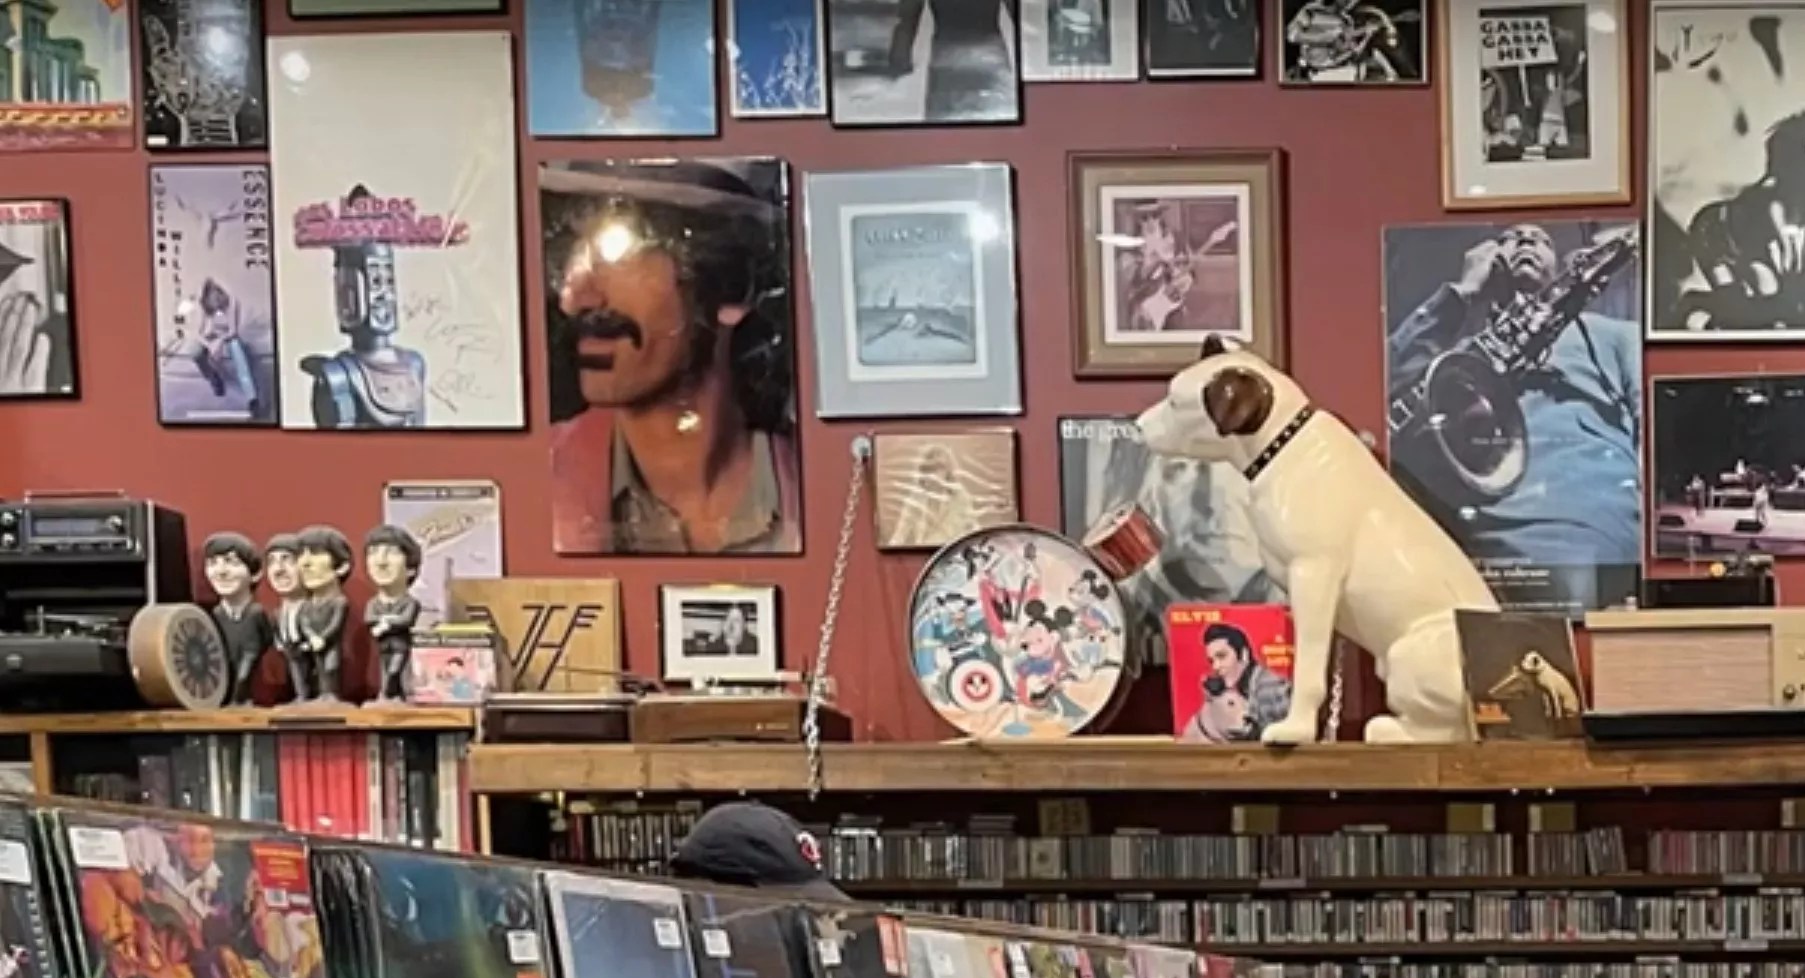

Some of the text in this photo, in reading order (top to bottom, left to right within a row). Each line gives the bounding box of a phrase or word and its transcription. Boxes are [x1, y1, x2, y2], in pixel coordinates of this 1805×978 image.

[1480, 20, 1548, 34] GABBA
[1482, 34, 1550, 49] GABBA
[1498, 47, 1540, 61] HEY
[242, 169, 268, 268] ESSENCE
[169, 230, 186, 341] WILLIMS
